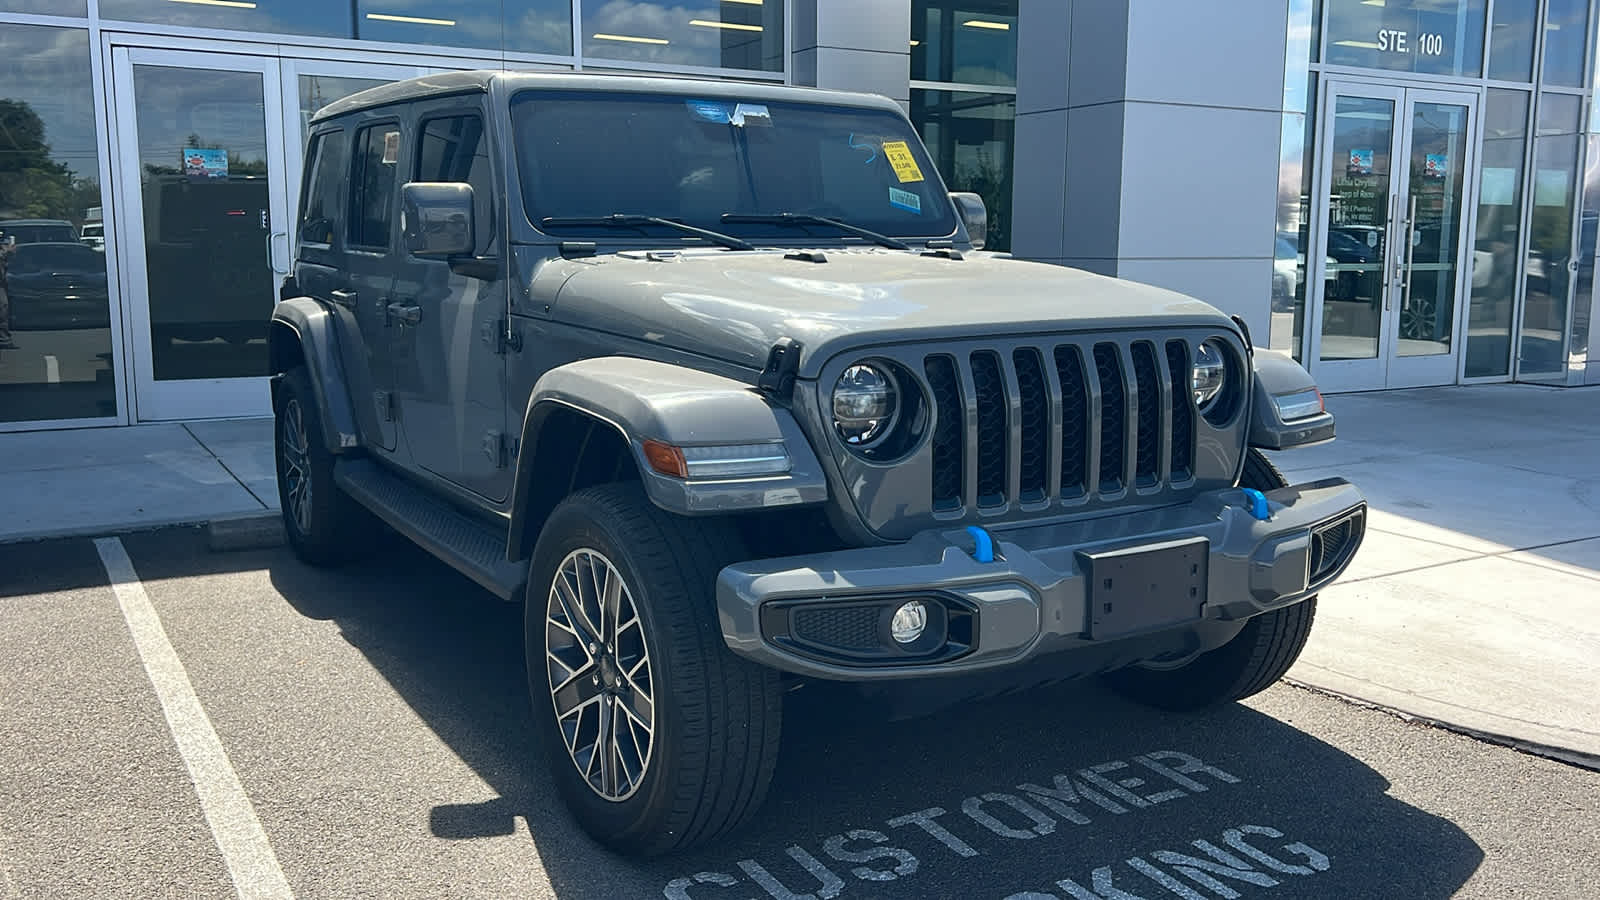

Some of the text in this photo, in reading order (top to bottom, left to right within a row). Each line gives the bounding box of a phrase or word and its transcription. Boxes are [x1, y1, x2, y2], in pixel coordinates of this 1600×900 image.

[1378, 28, 1442, 55] STE. 100
[663, 750, 1242, 900] CUSTOMER
